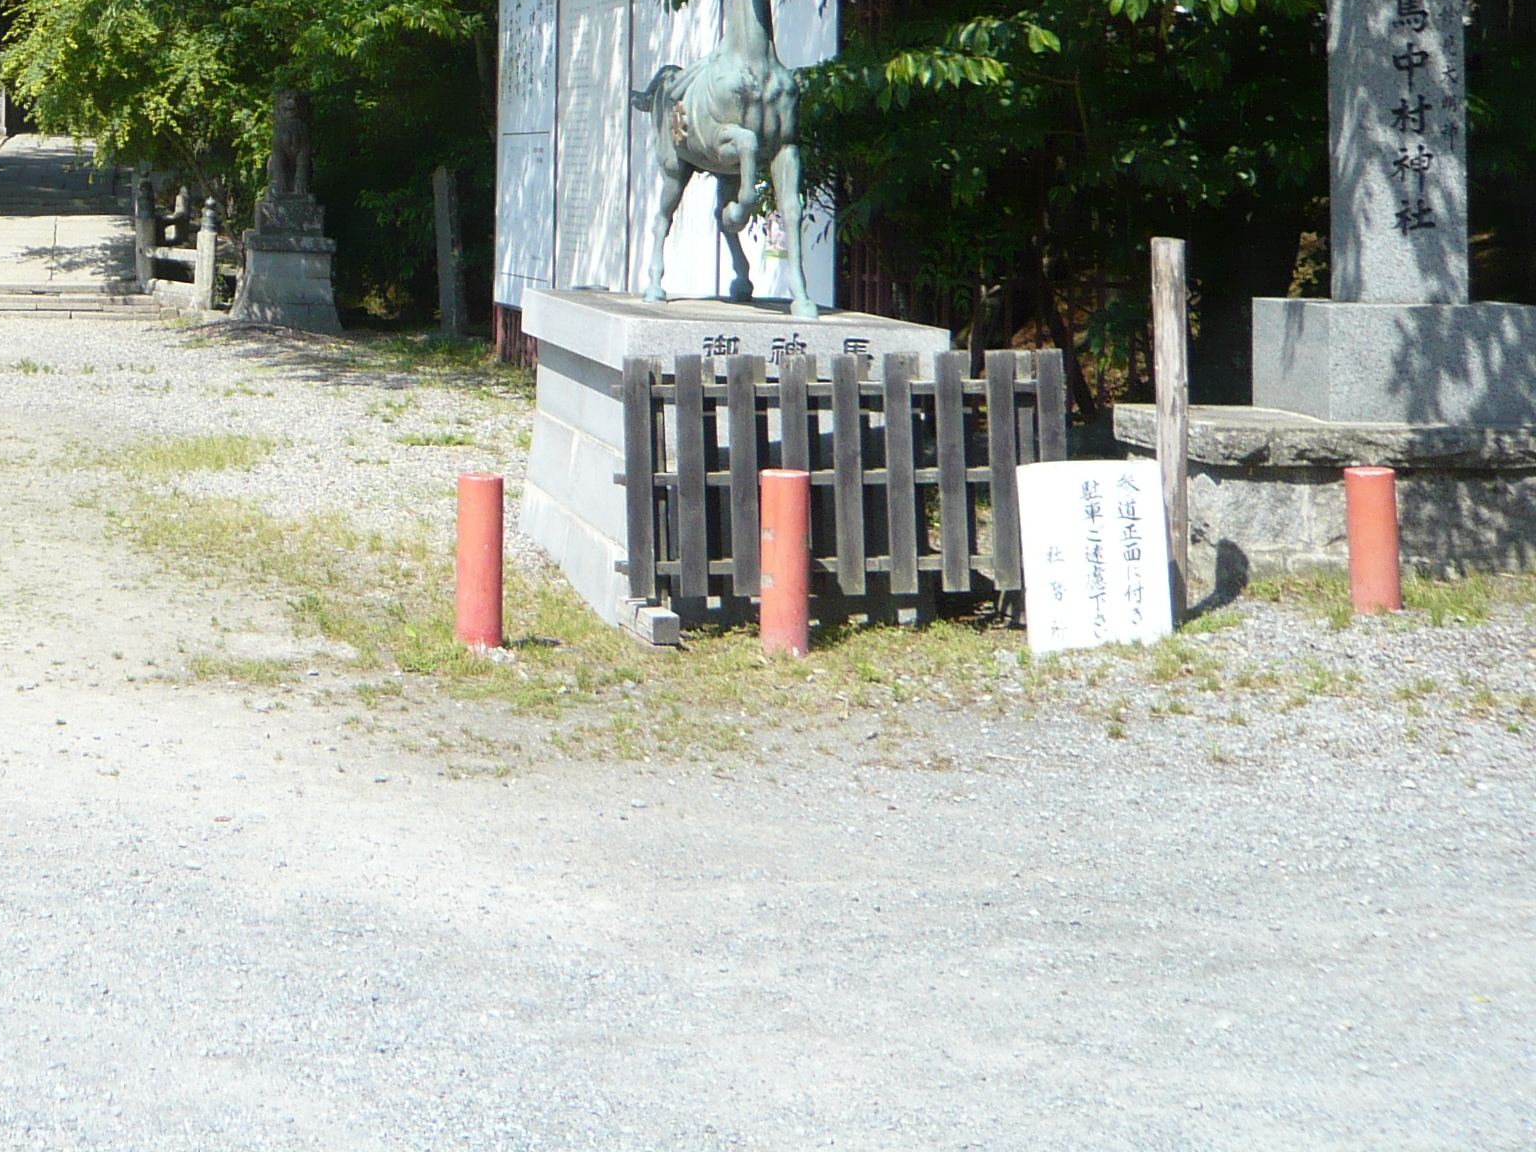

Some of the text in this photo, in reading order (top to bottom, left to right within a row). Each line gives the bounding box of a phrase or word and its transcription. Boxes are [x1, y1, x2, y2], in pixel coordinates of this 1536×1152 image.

[1045, 545, 1069, 642] 社務所
[1080, 479, 1108, 640] 駐車ご遠慮下さい
[1116, 472, 1145, 626] 参道正面に付き
